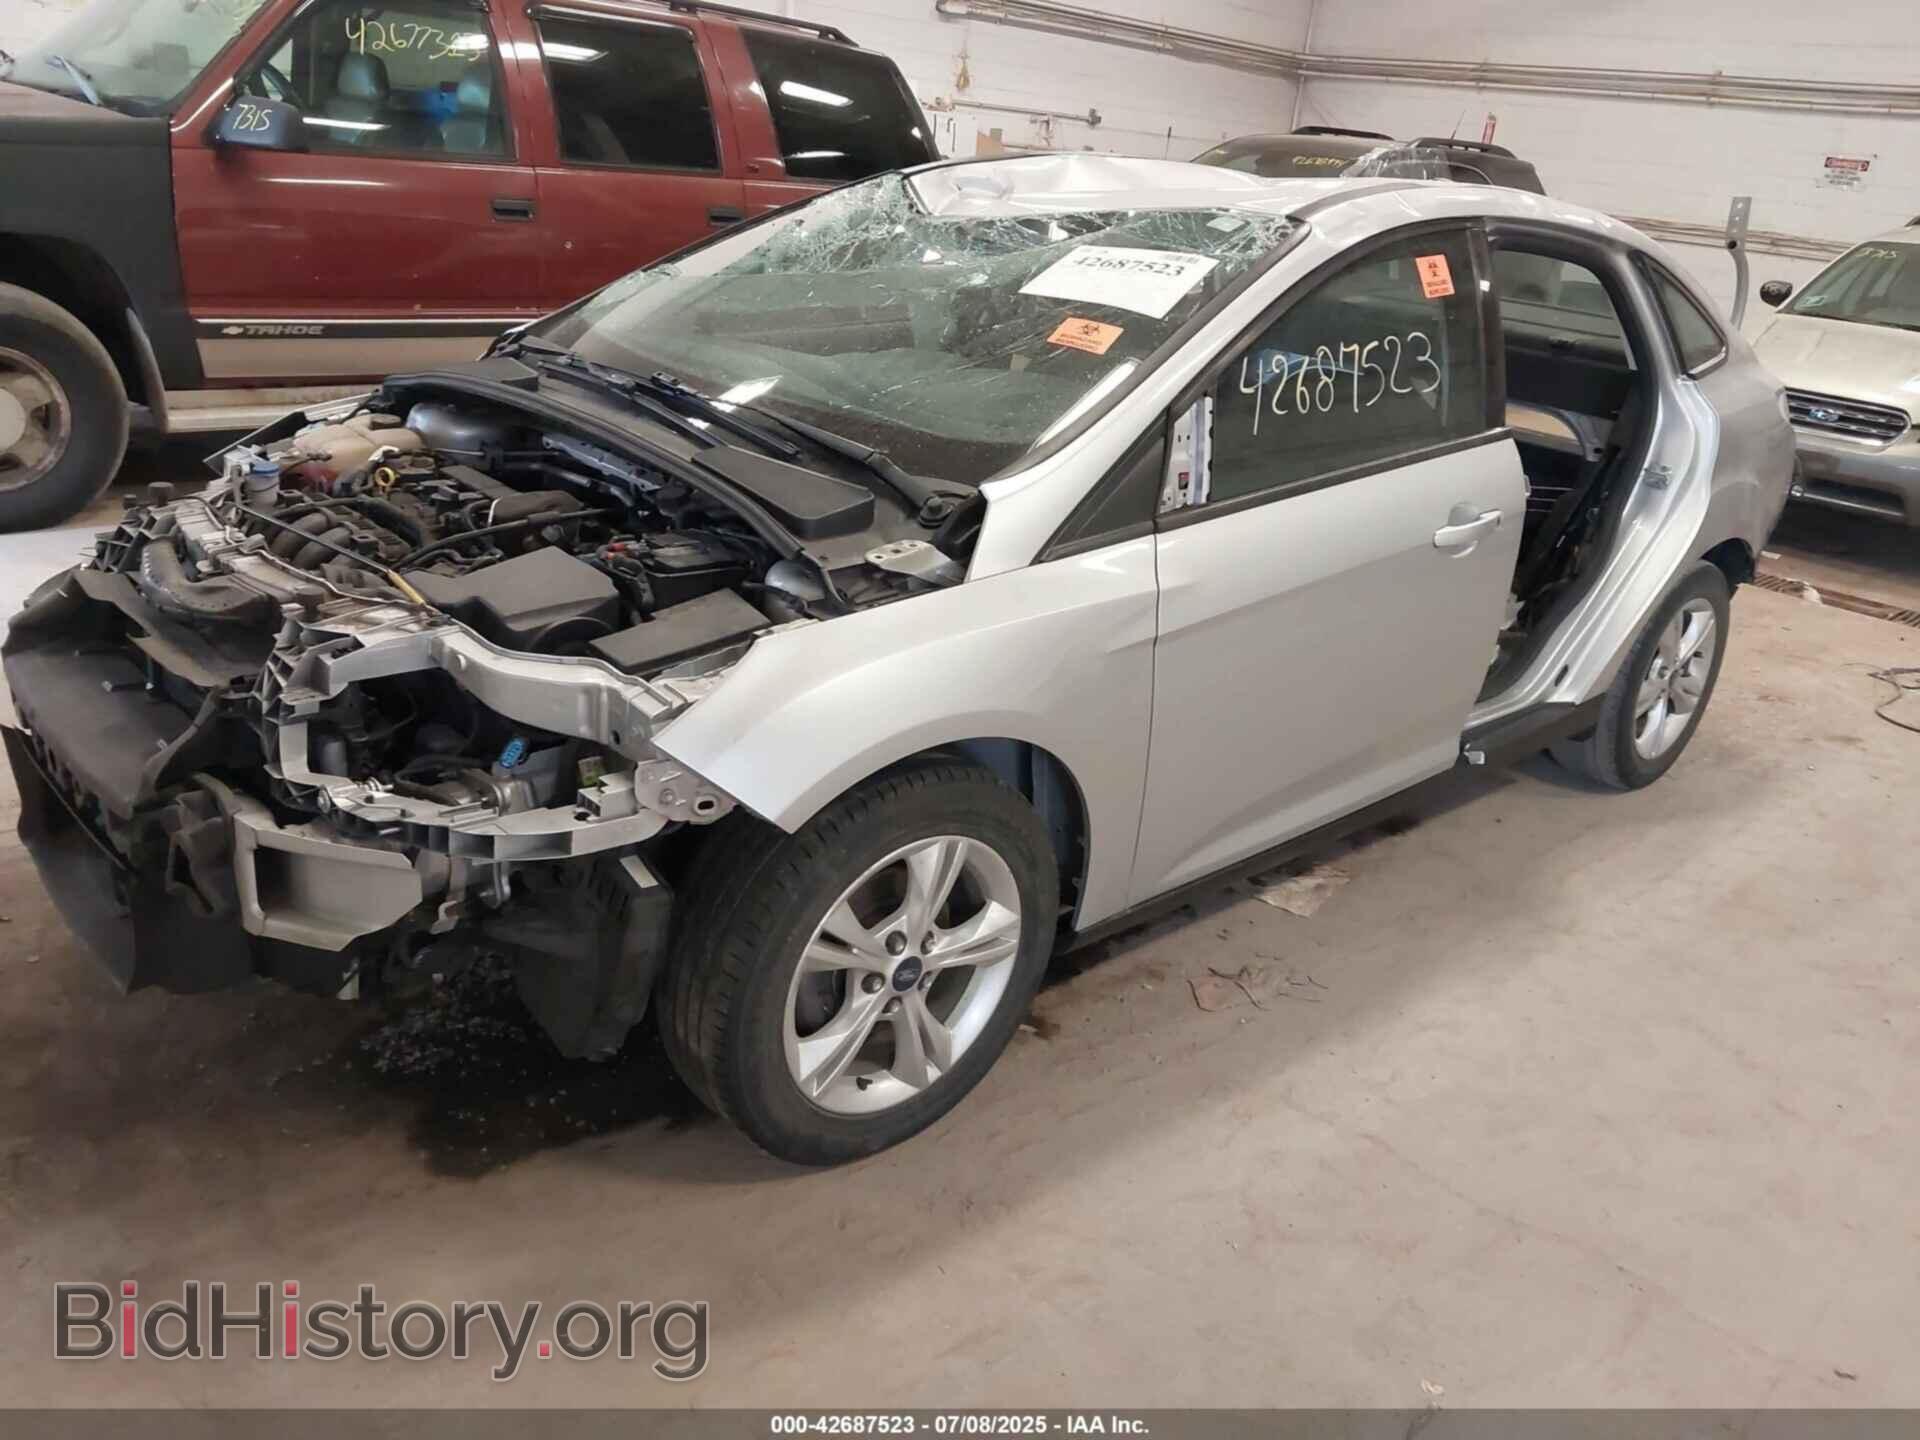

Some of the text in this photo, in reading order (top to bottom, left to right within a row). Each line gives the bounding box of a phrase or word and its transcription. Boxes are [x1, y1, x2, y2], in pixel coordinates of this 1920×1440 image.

[232, 103, 273, 132] 7315
[1074, 255, 1186, 277] 42687523
[245, 324, 324, 336] TAHOE
[1239, 331, 1441, 436] 42687523
